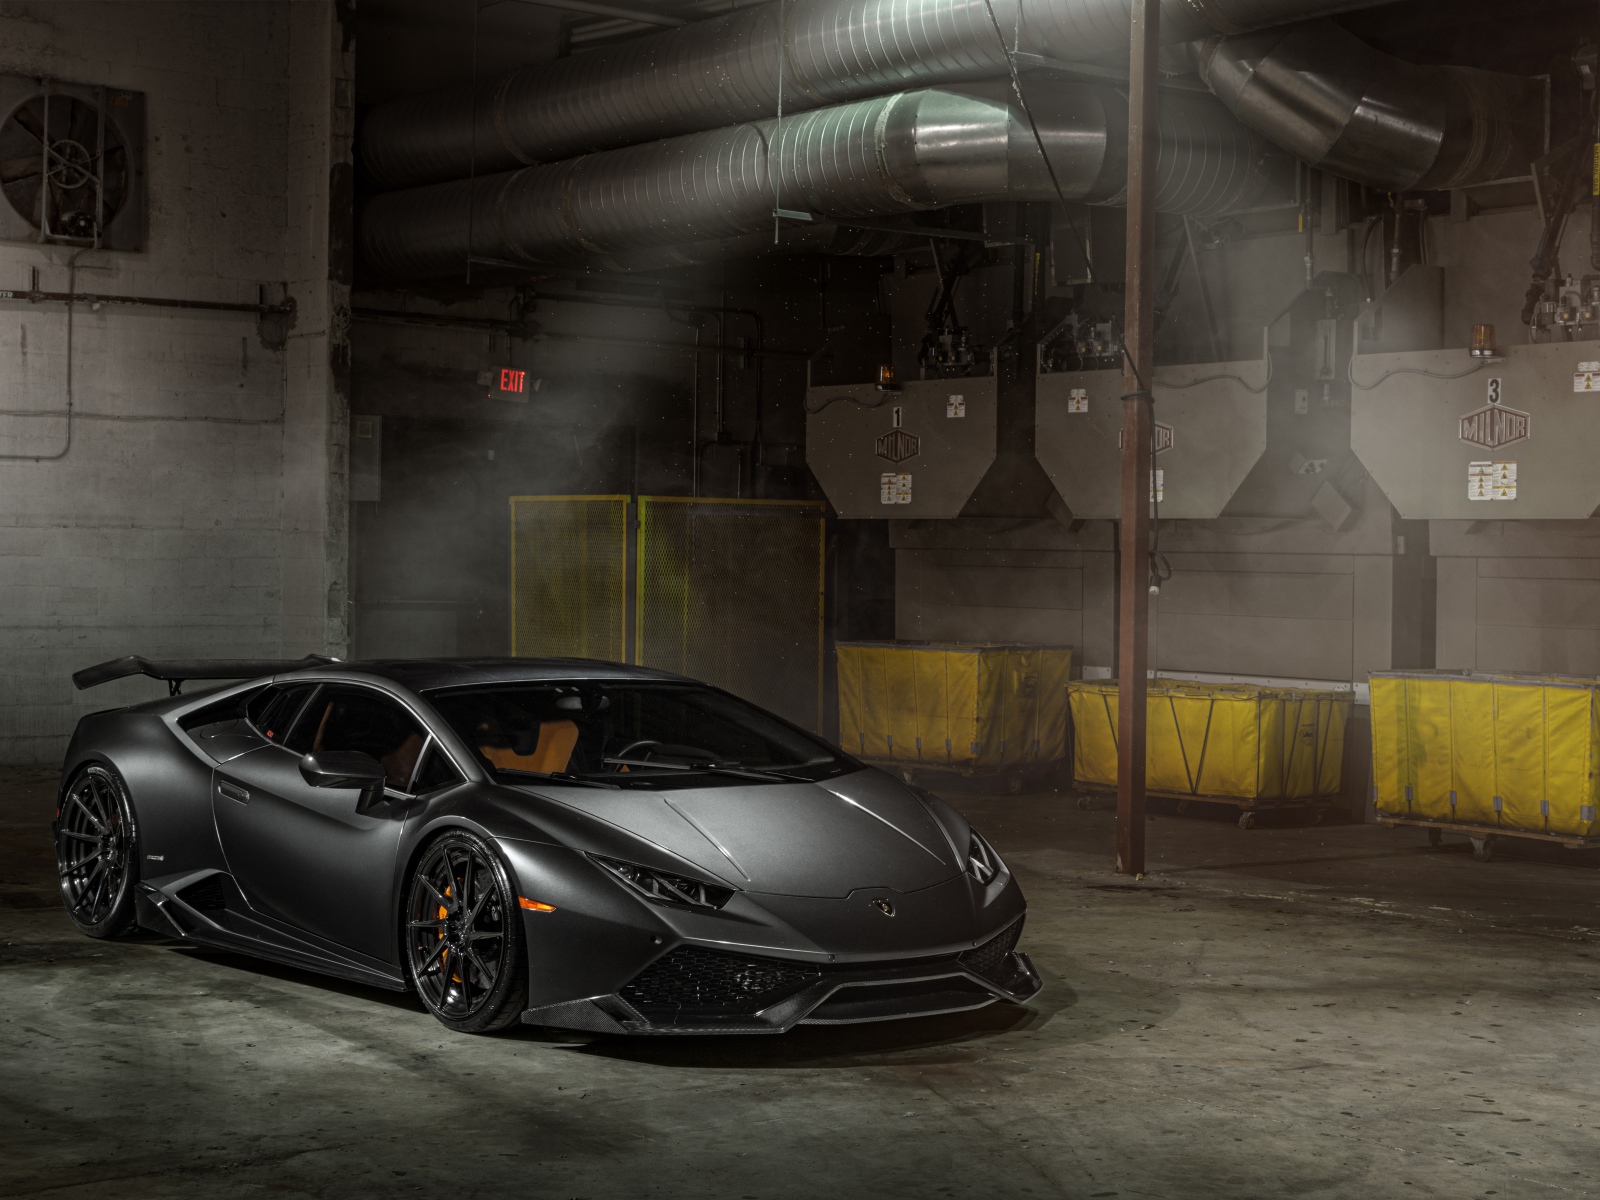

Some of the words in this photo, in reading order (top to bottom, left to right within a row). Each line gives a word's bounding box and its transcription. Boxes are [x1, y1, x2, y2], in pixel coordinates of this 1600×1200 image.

[501, 369, 525, 393] EXIT
[1489, 378, 1500, 403] 3
[895, 408, 901, 427] 1
[1463, 409, 1525, 446] MILNOR
[878, 431, 917, 461] MILNOR
